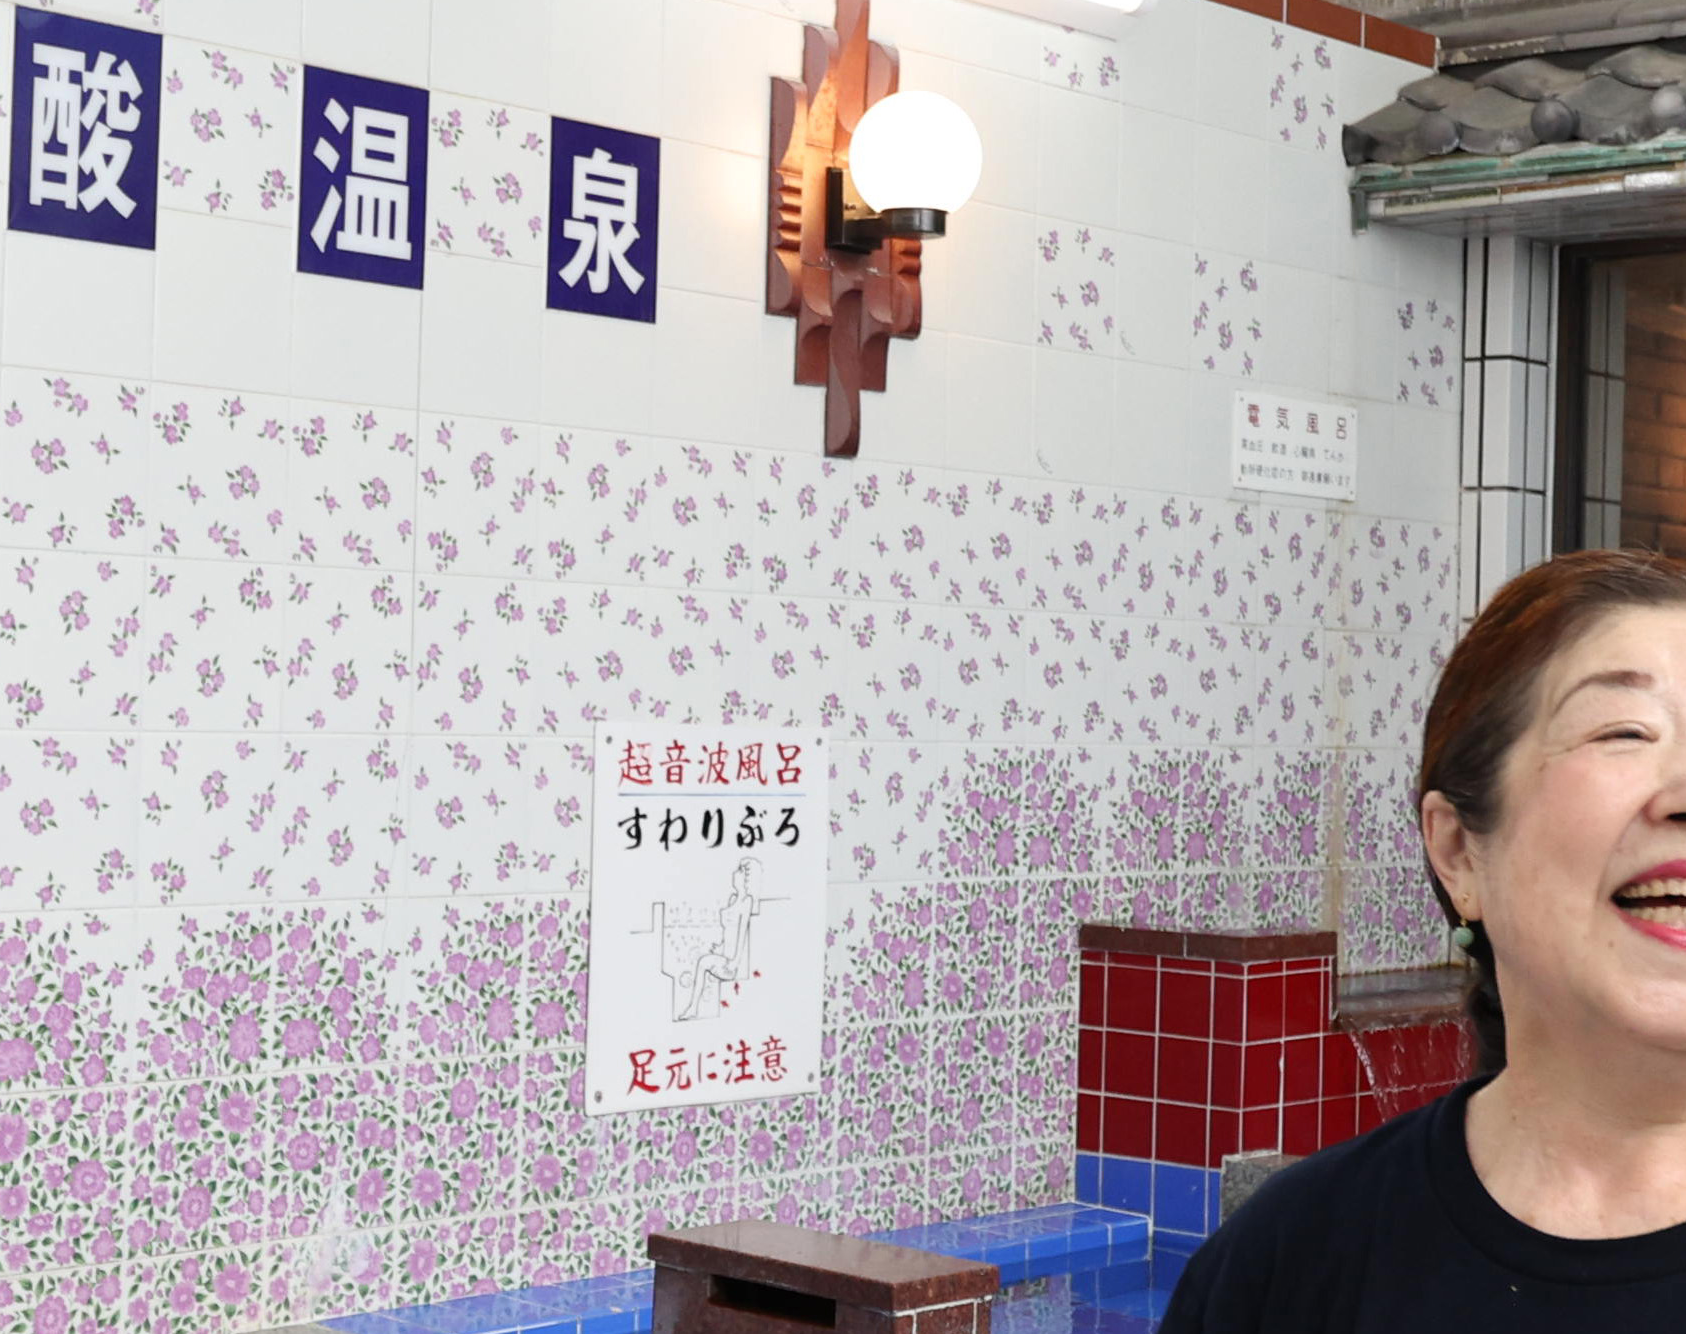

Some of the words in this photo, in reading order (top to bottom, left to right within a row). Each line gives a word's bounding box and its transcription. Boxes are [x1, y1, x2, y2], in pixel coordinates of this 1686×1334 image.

[617, 739, 803, 787] 超音波風呂
[617, 804, 802, 852] すわりぶろ
[626, 1034, 789, 1097] 足元に注意
